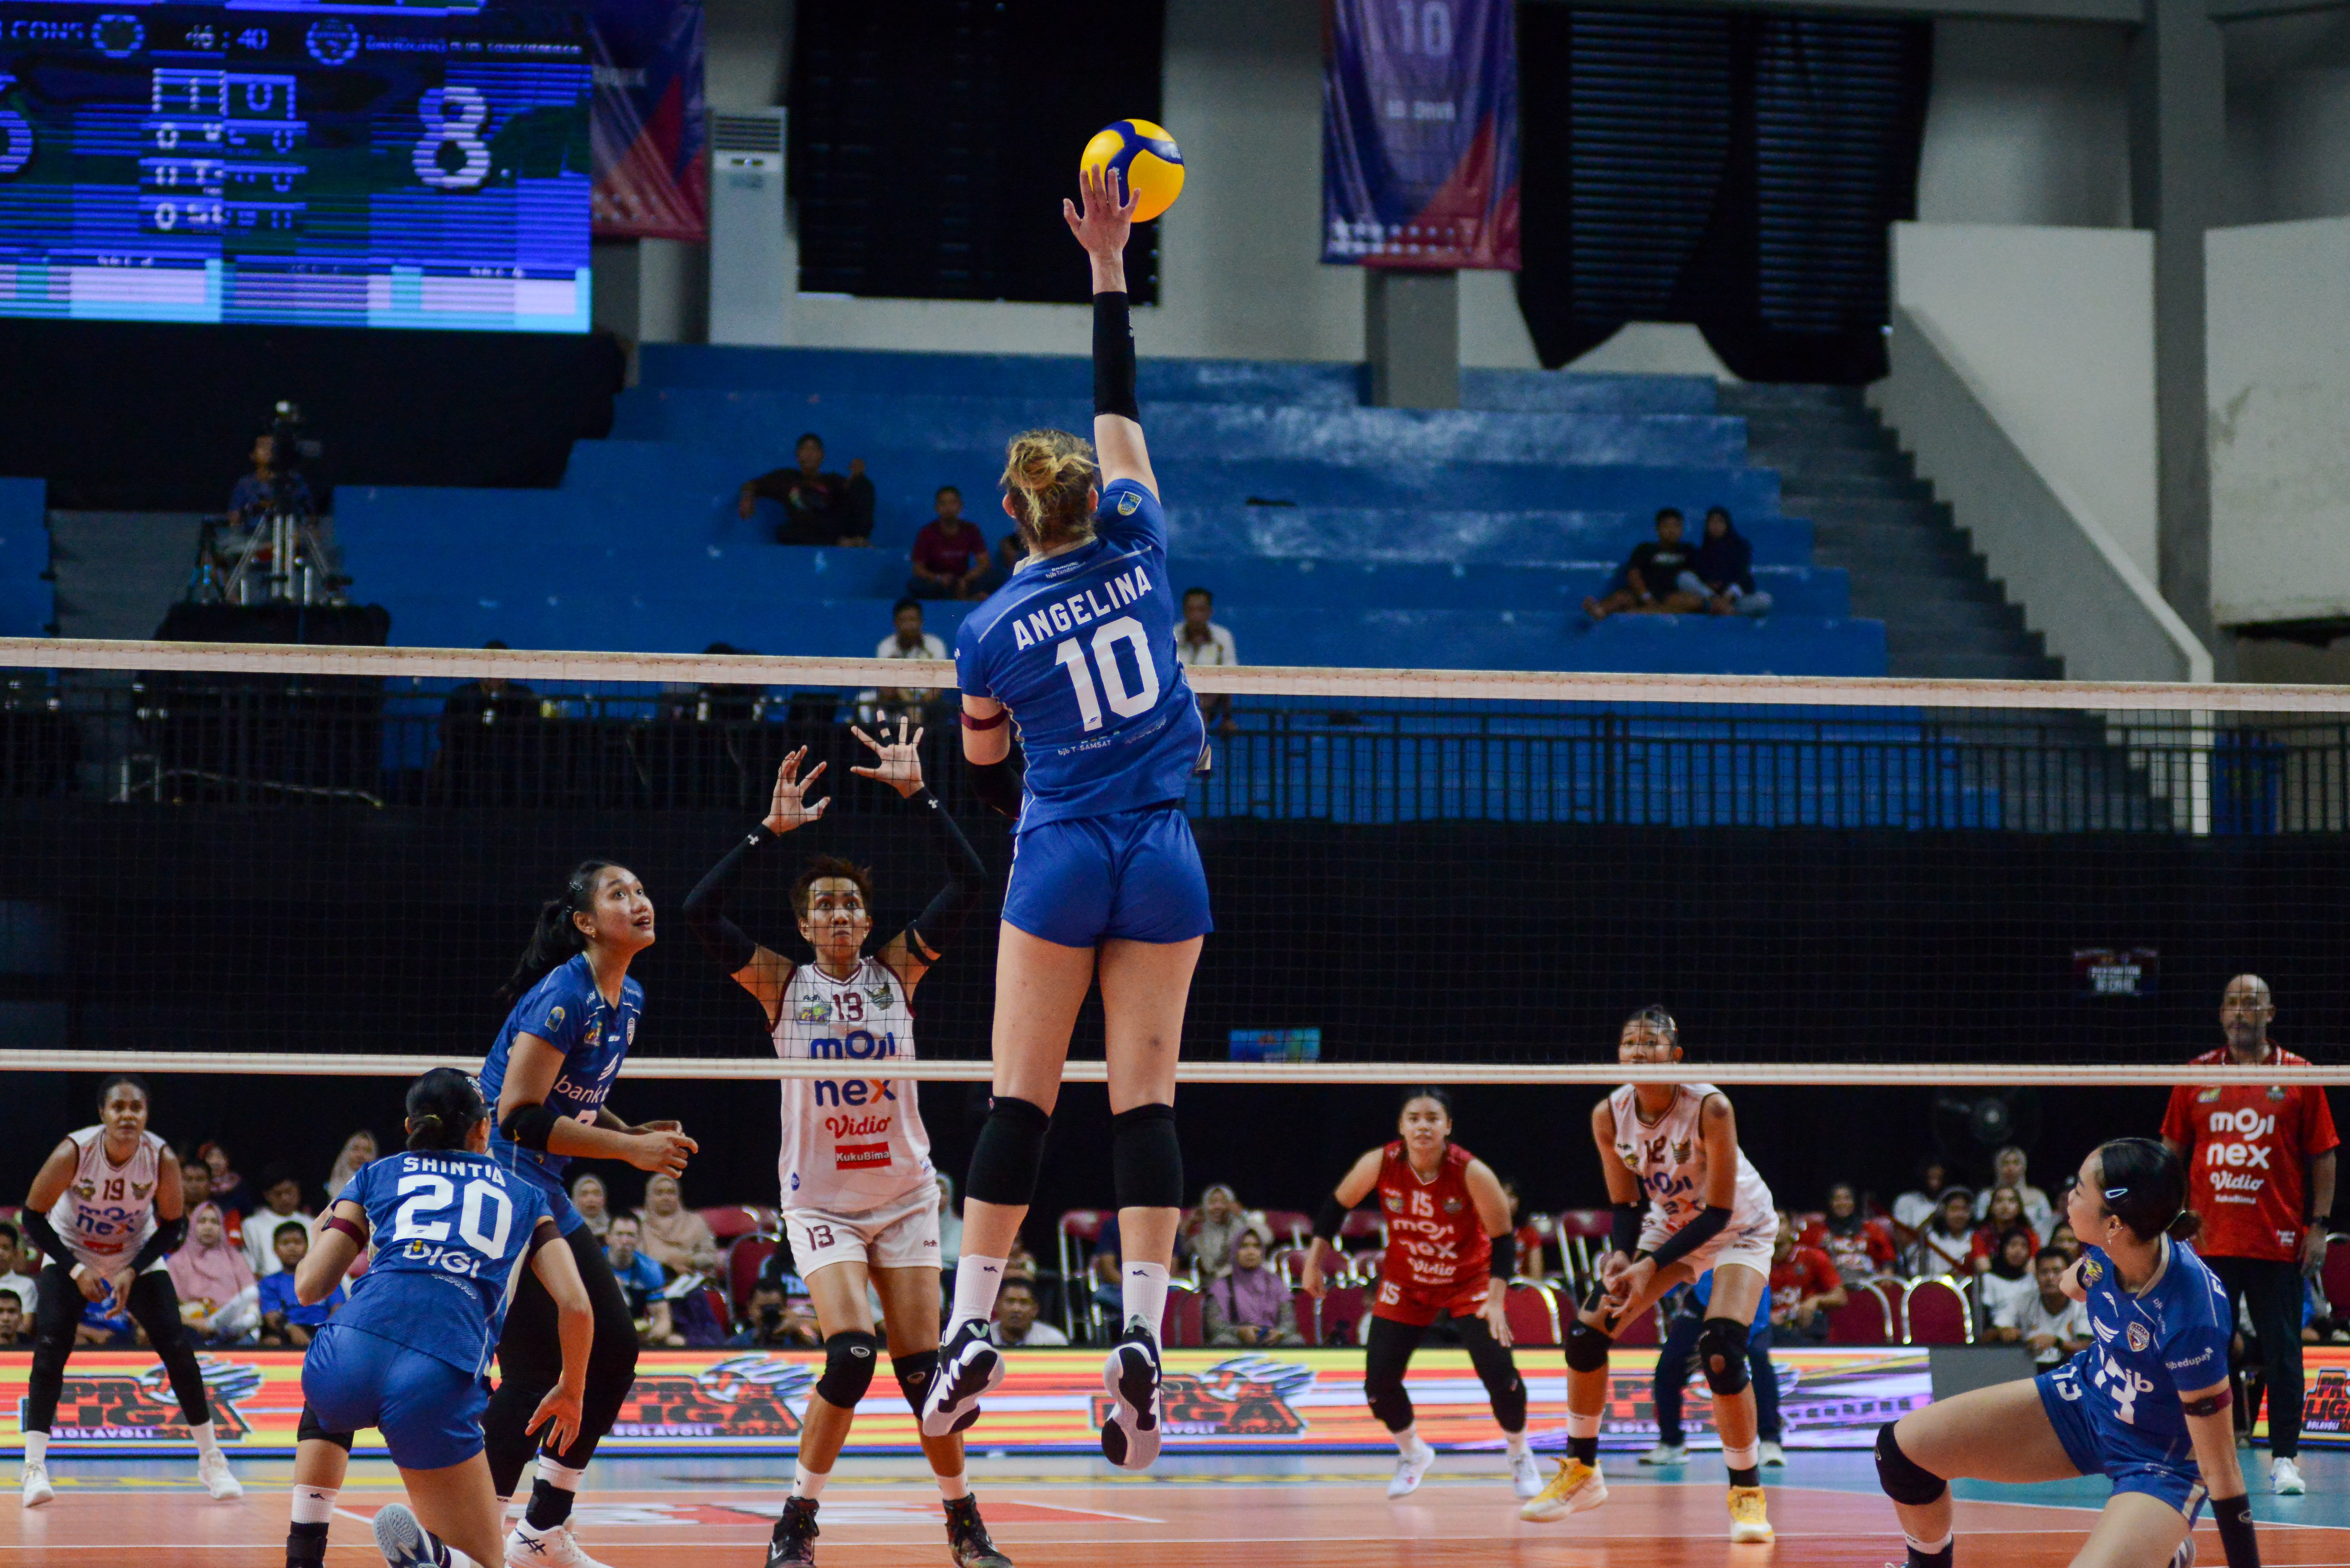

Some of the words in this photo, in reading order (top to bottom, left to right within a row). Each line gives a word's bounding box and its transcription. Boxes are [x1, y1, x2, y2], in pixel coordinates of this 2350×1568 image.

[1397, 1, 1453, 56] 10
[413, 87, 492, 189] 8
[1012, 565, 1153, 650] ANGELINA
[1055, 616, 1160, 732] 10
[833, 992, 864, 1021] 13
[814, 1079, 896, 1107] nex
[825, 1115, 892, 1139] Vidio
[836, 1151, 891, 1162] KukuBima
[2206, 1142, 2272, 1169] nex
[403, 1157, 506, 1187] SHINTIA
[2209, 1170, 2265, 1191] Vidio
[103, 1177, 125, 1201] 19
[1412, 1189, 1434, 1218] 15
[392, 1174, 513, 1260] 20
[806, 1225, 835, 1252] 13
[402, 1241, 480, 1279] DIGI
[1380, 1280, 1401, 1306] 15
